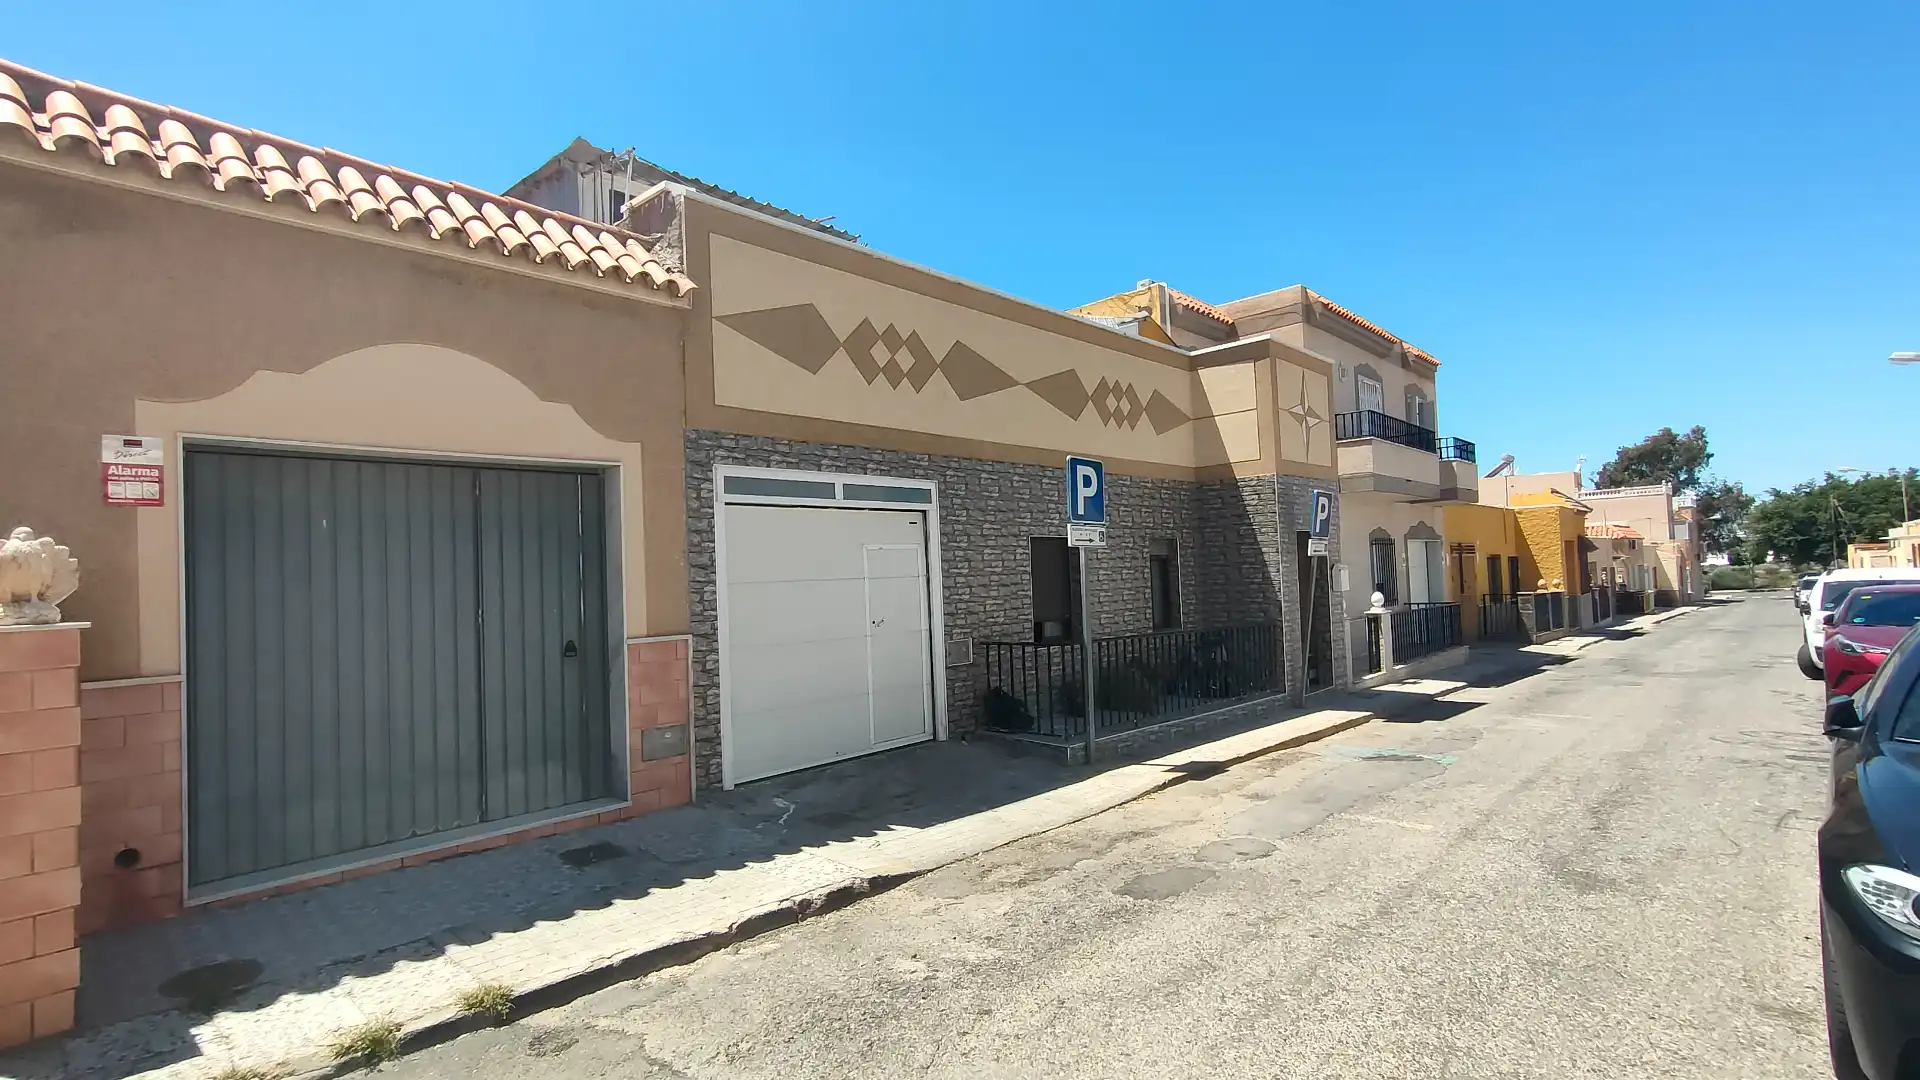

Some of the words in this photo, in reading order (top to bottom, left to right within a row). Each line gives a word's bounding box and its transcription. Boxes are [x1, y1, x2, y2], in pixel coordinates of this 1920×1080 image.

[107, 465, 159, 477] Alarma
[1077, 465, 1097, 515] P
[1316, 496, 1329, 533] P
